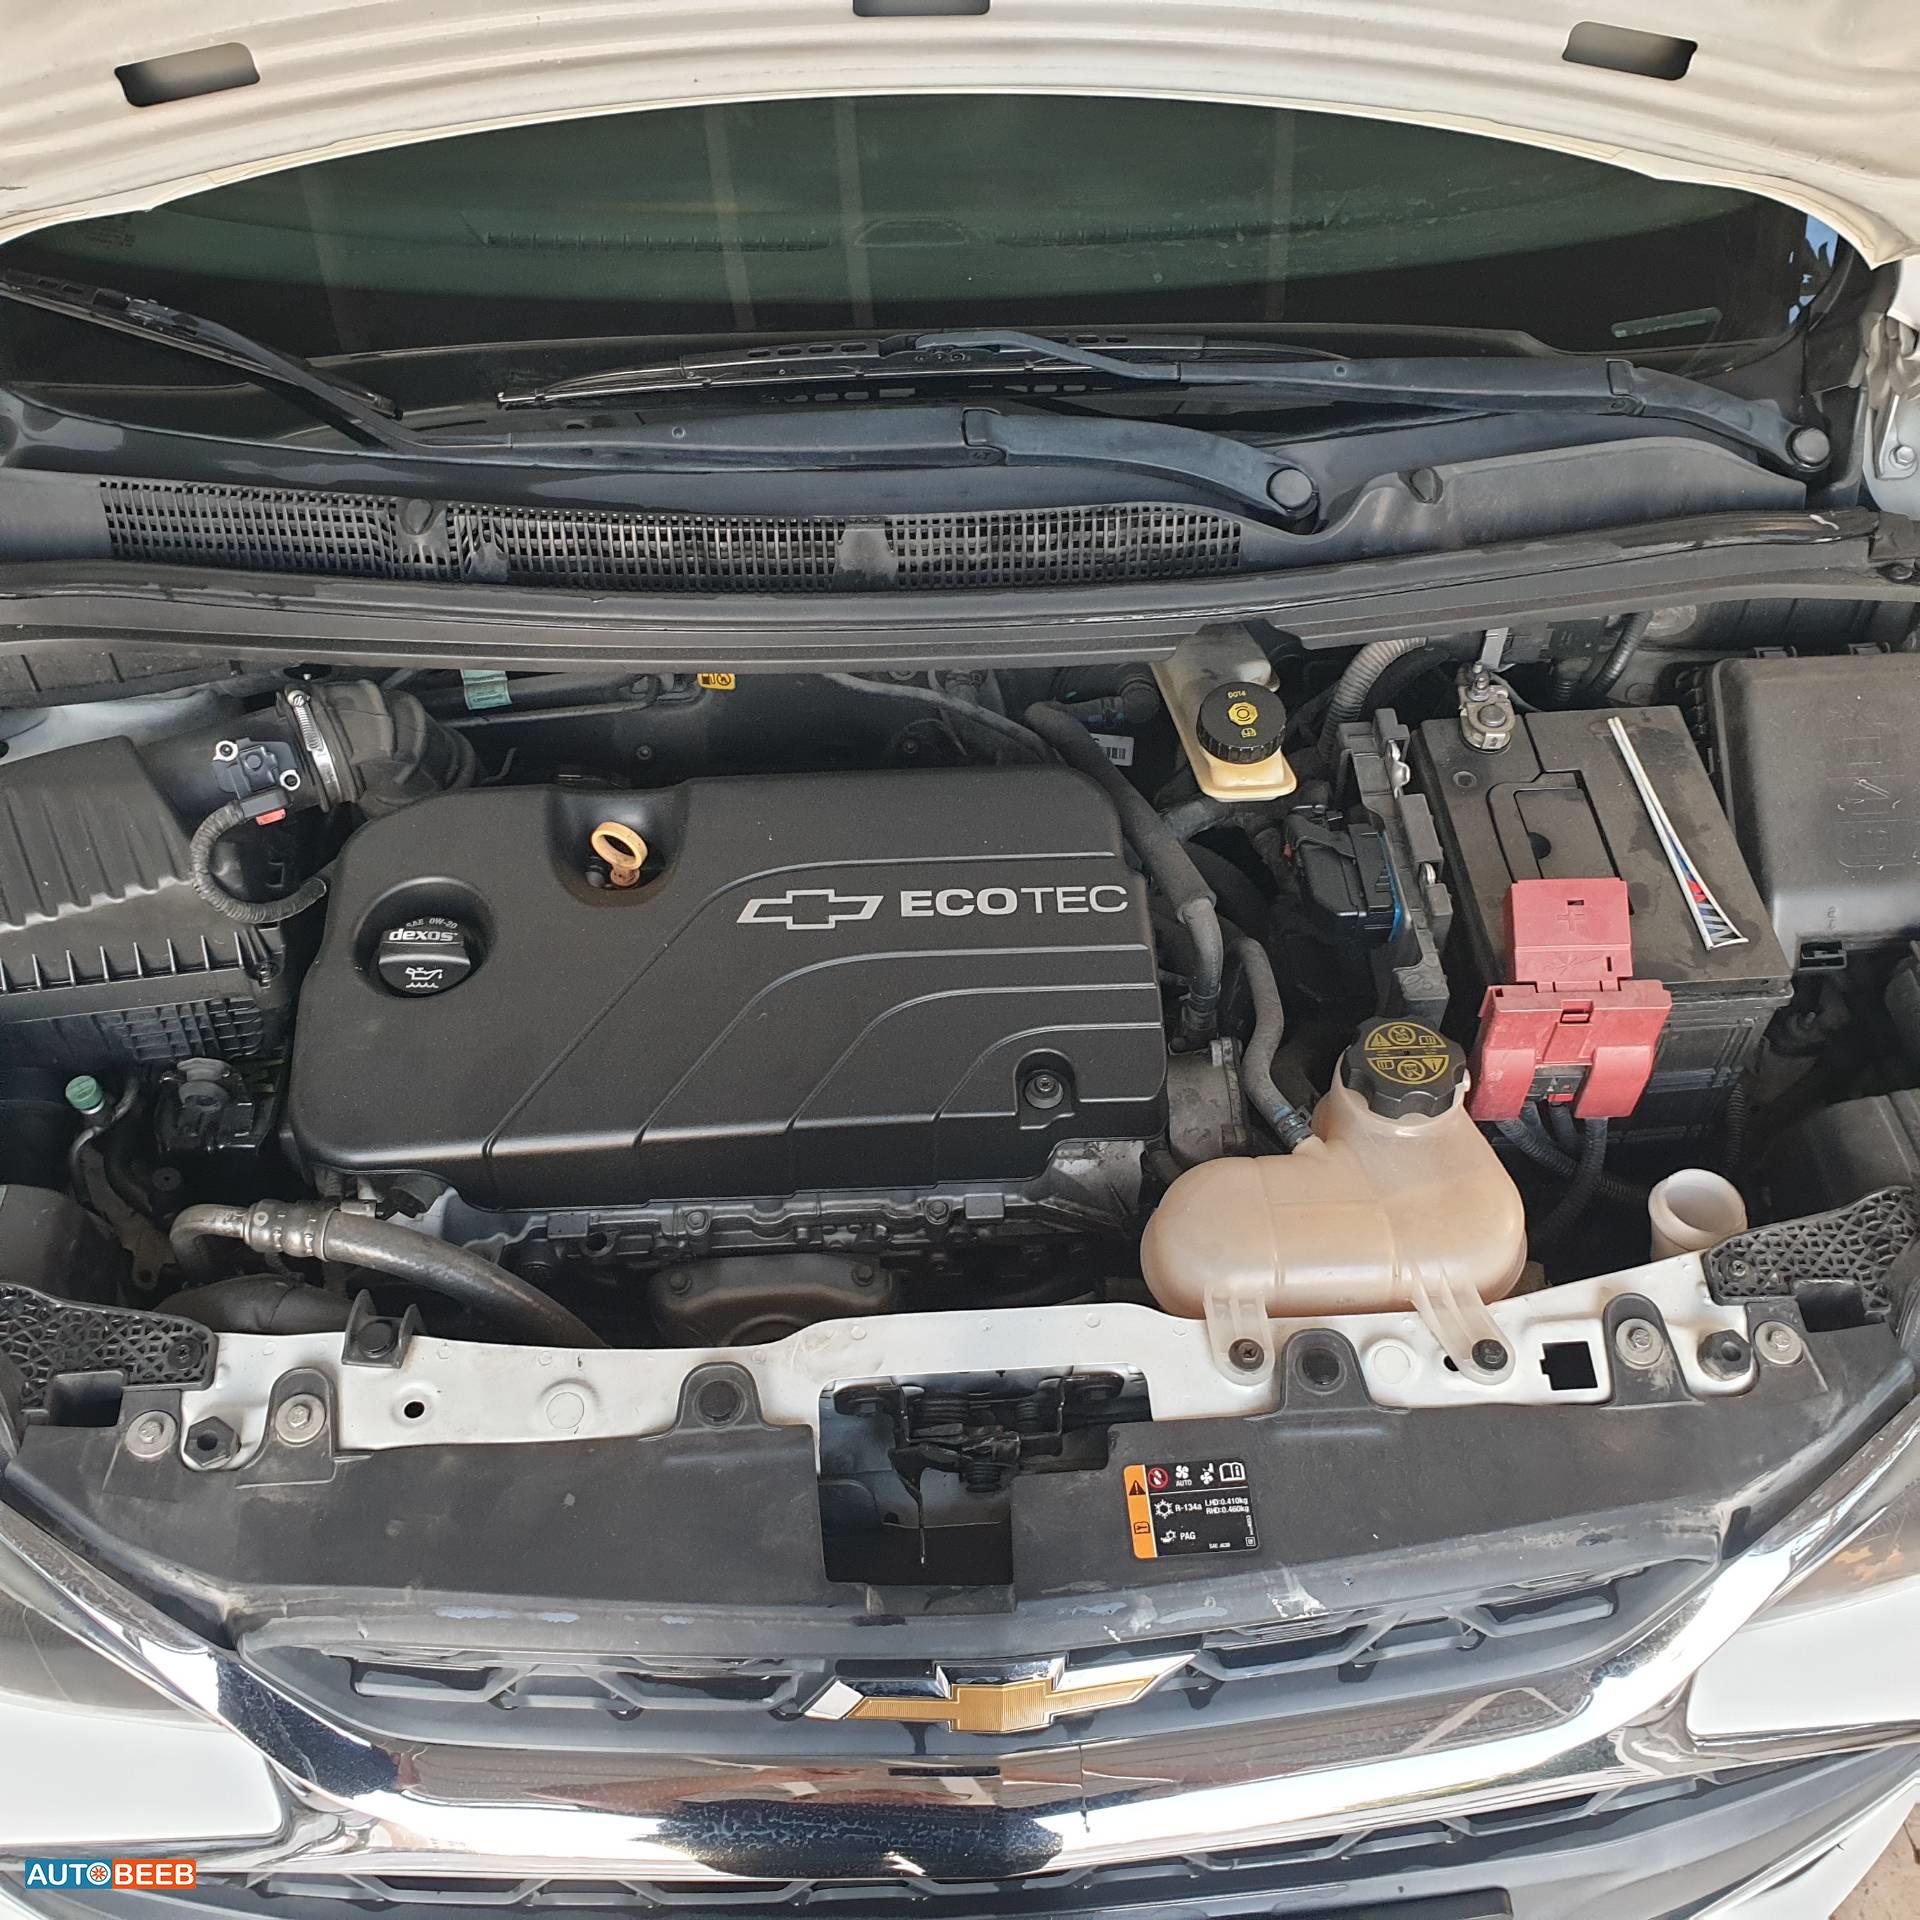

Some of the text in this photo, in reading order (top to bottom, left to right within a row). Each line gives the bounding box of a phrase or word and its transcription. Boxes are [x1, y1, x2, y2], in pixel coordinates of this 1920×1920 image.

[900, 885, 1129, 918] ECOTEC
[389, 928, 454, 941] dexos
[1175, 1503, 1202, 1512] R-134a
[1180, 1532, 1196, 1540] PAG
